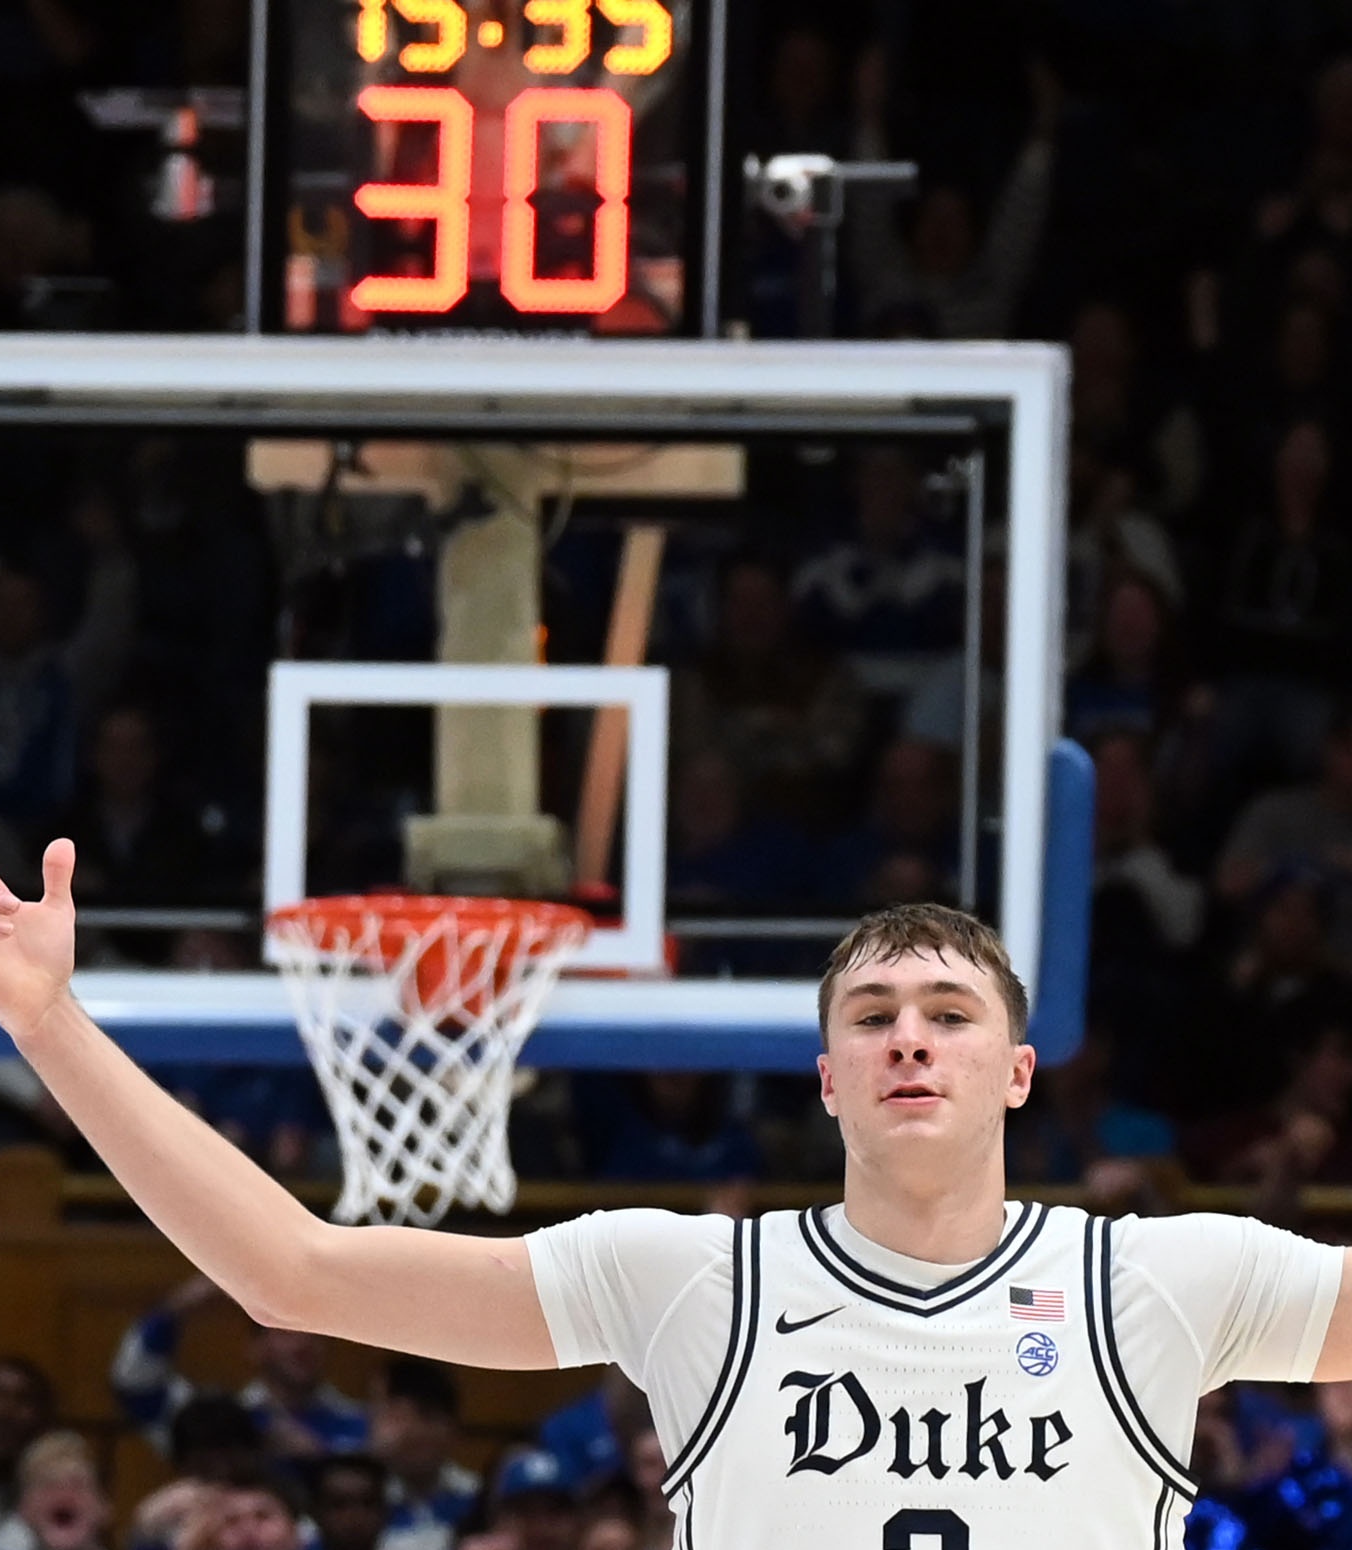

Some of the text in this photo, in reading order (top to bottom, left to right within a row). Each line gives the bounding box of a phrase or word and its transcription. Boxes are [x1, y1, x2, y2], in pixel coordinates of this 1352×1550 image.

[357, 0, 672, 76] 15:35
[351, 86, 632, 313] 30
[1022, 1346, 1056, 1362] ACC
[779, 1371, 1073, 1482] Duke
